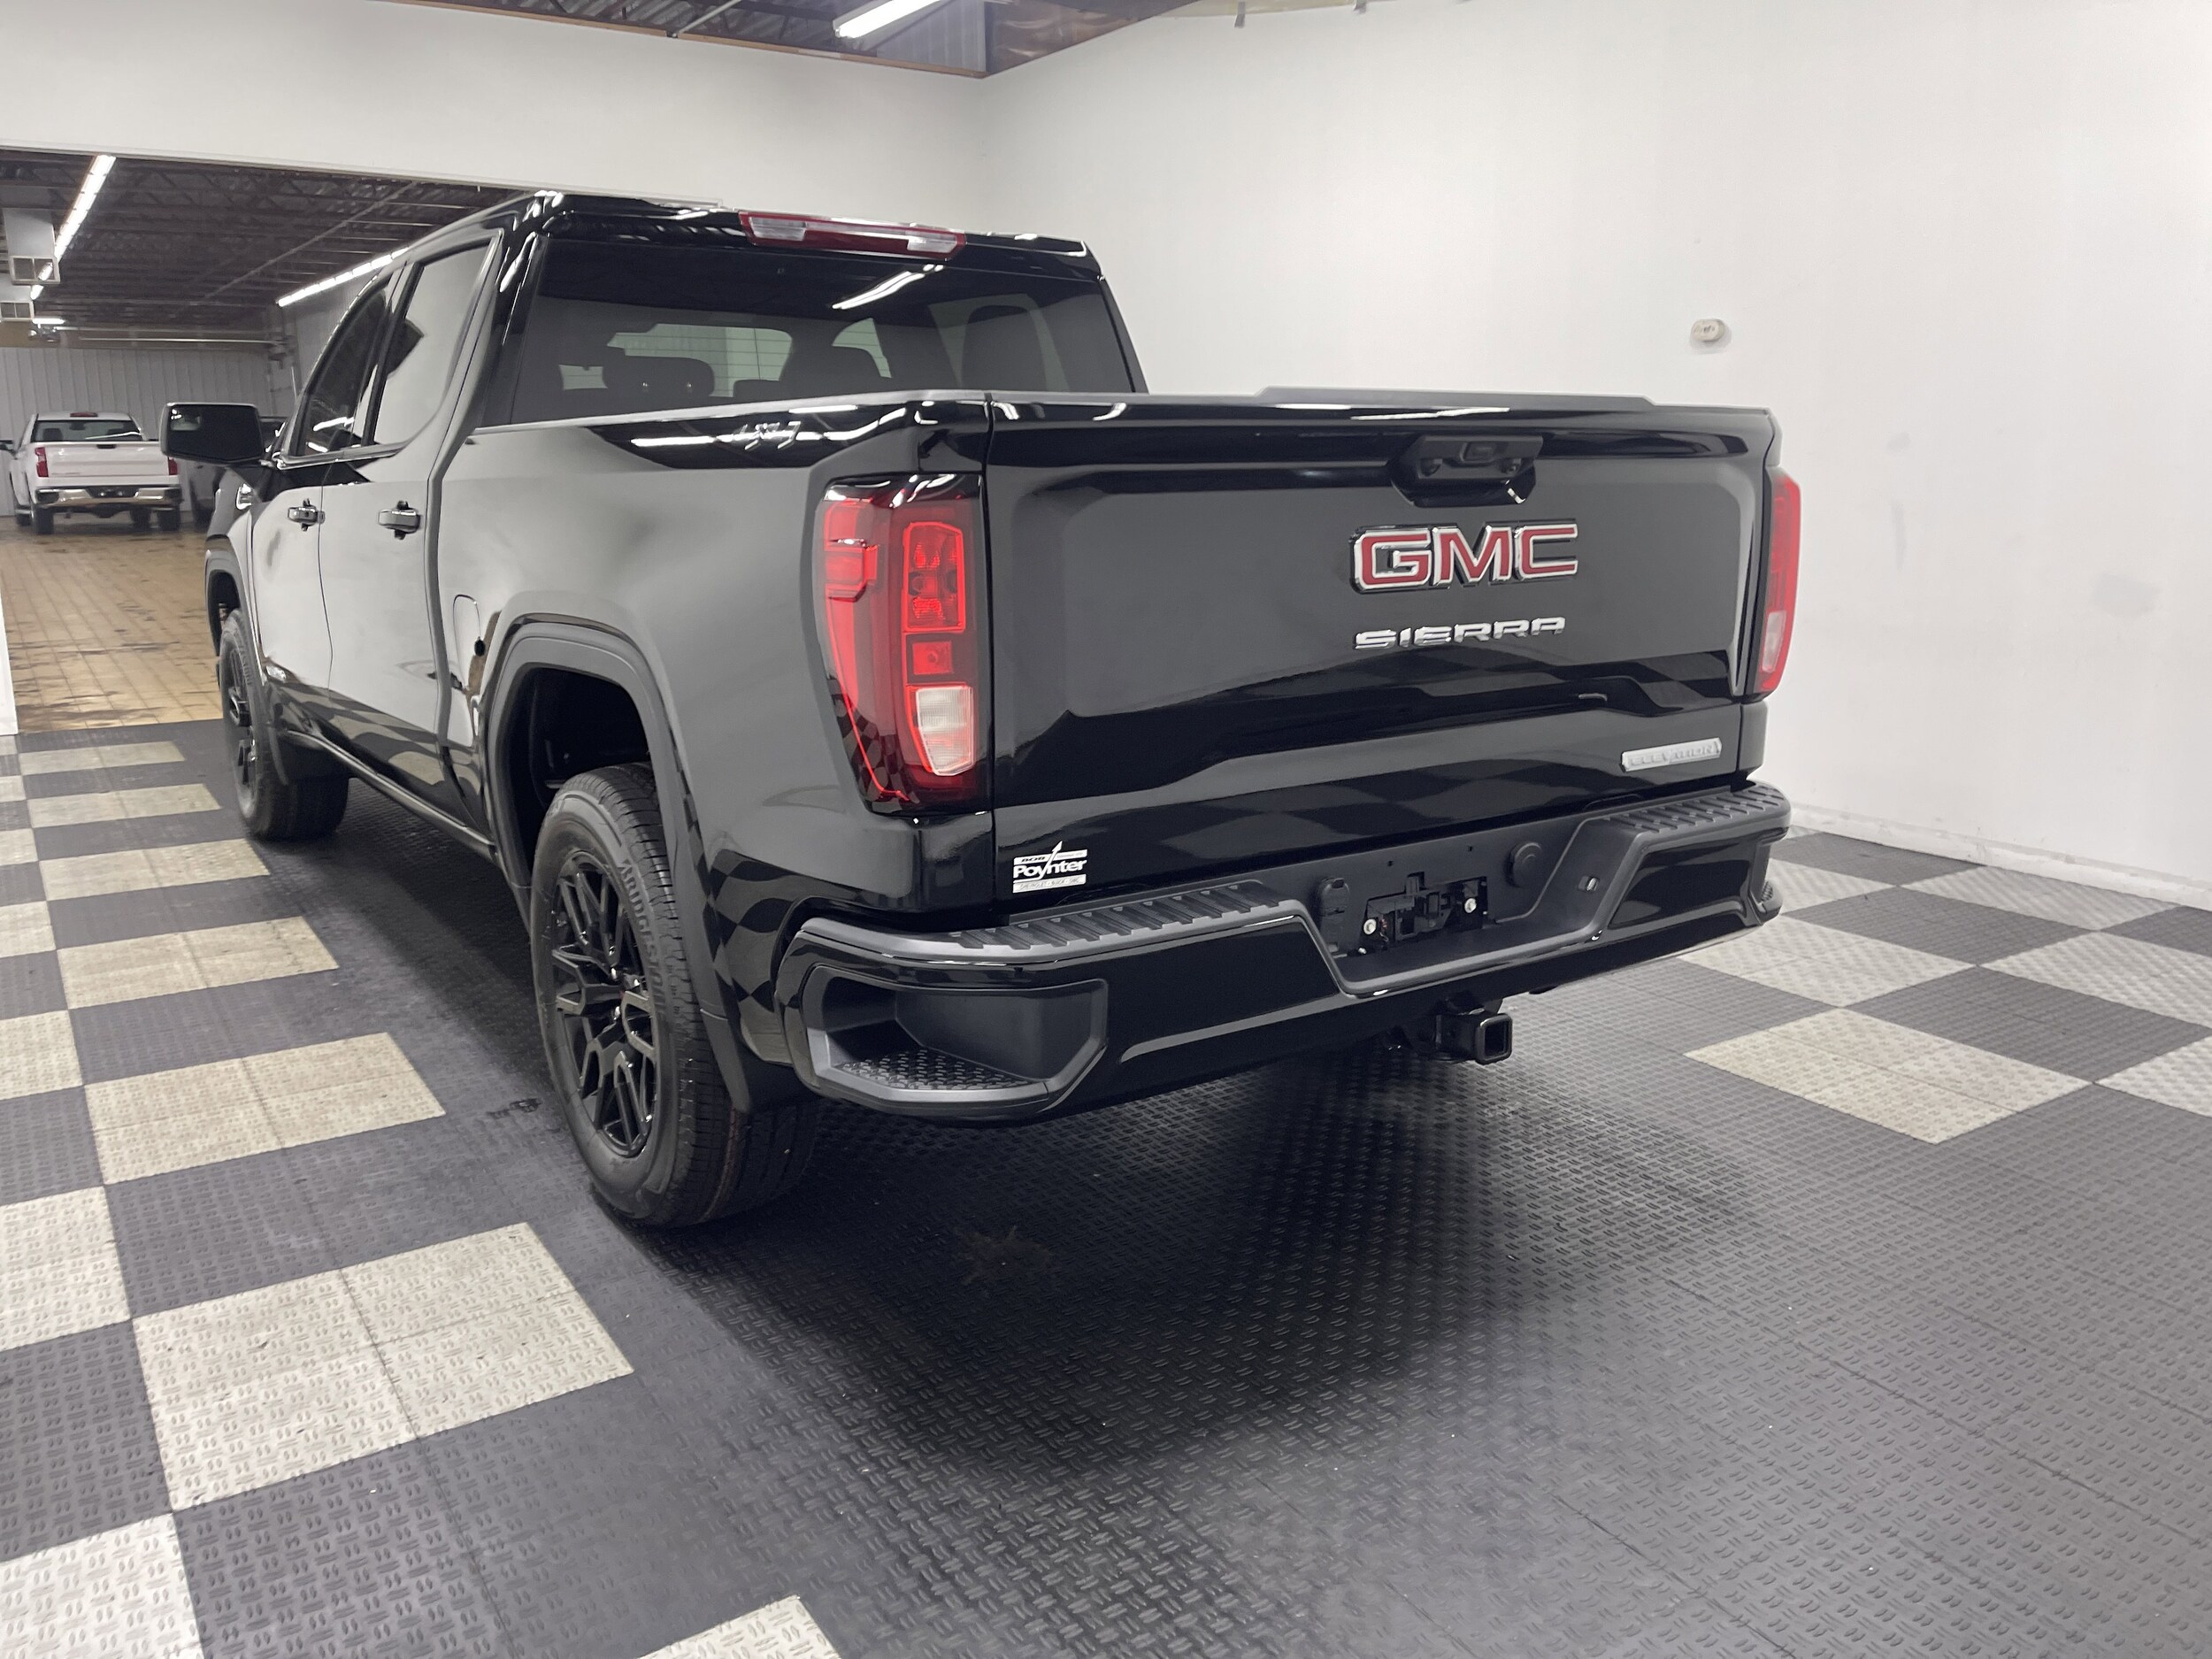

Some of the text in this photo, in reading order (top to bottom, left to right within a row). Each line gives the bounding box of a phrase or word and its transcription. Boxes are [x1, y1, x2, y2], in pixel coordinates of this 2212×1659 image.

[1352, 522, 1578, 591] GMC
[1355, 616, 1566, 649] SIERRA
[1012, 859, 1087, 879] Poynter
